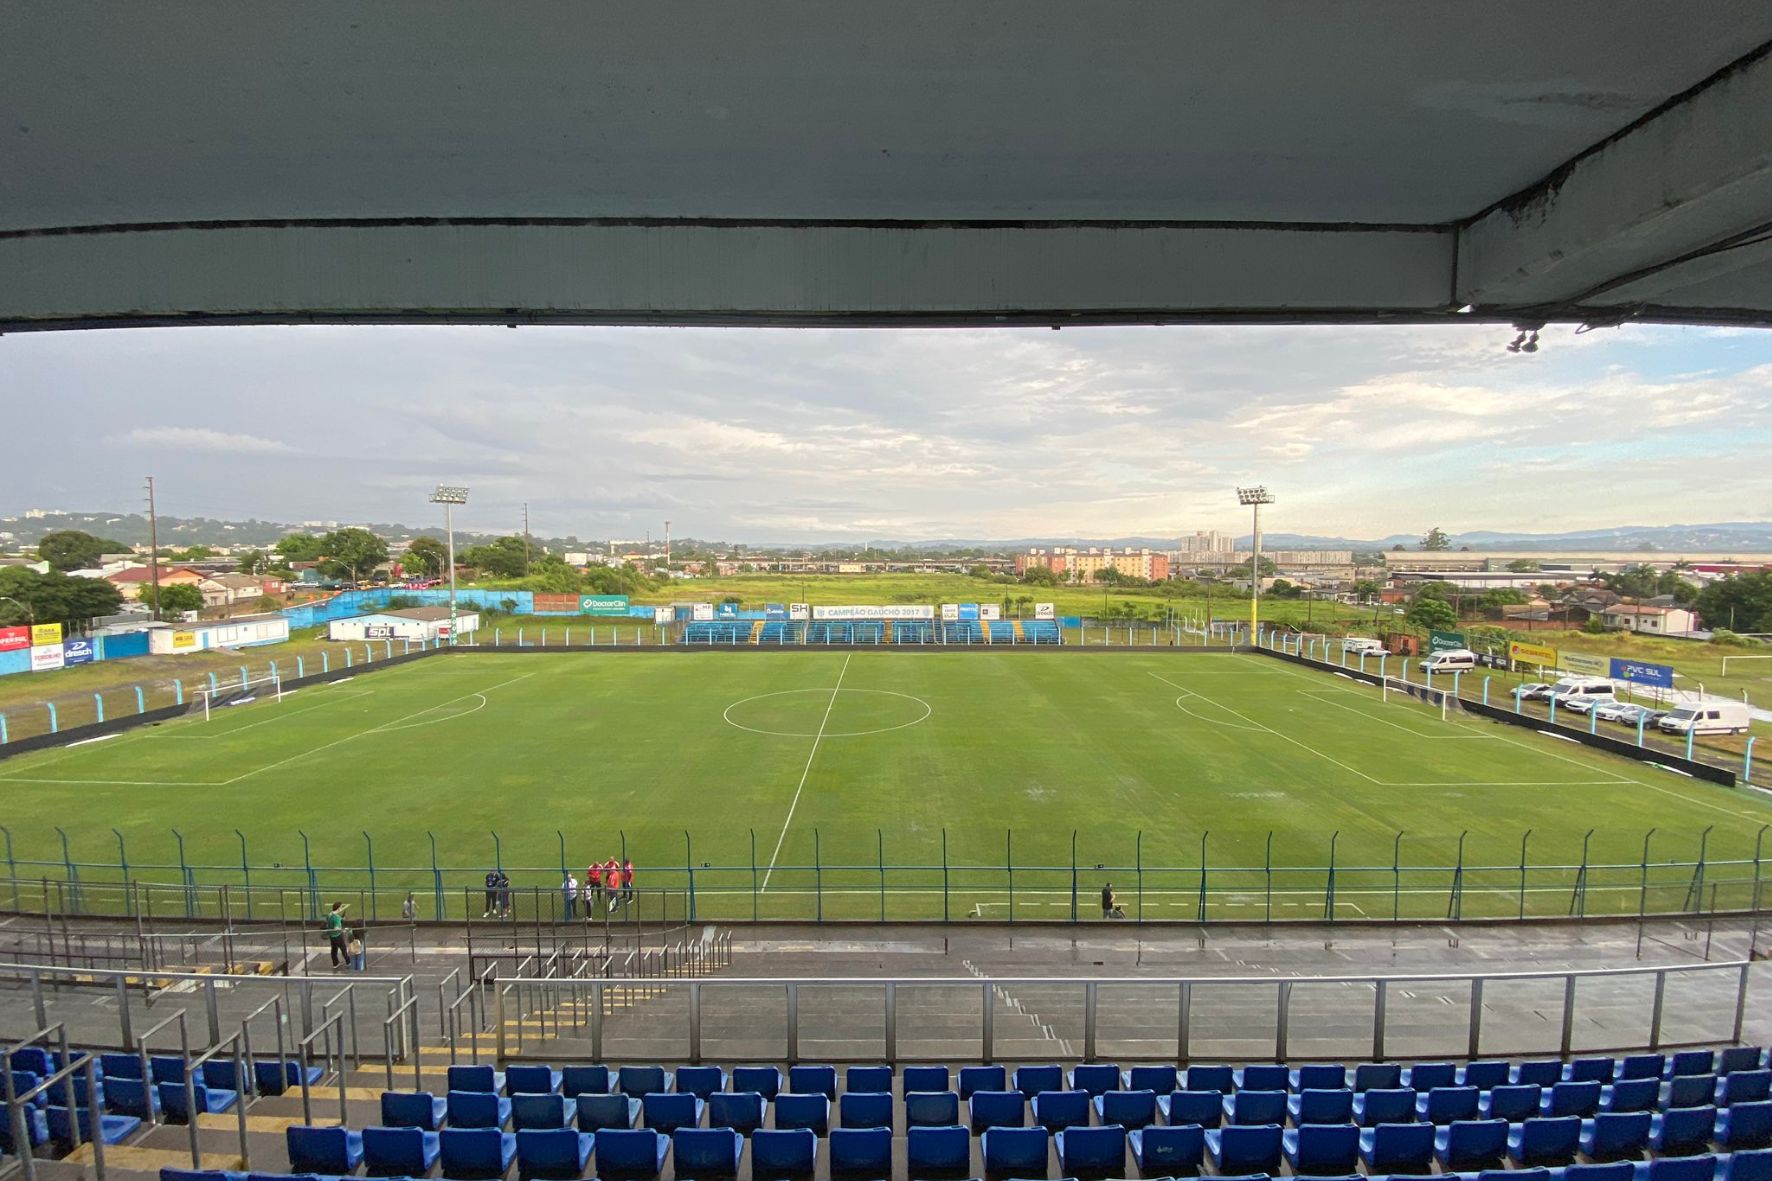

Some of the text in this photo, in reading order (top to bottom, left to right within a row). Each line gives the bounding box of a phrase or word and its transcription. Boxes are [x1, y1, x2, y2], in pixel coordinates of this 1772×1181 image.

[791, 605, 808, 613] SH
[902, 608, 920, 616] 2017
[1626, 664, 1662, 677] PVC SUL
